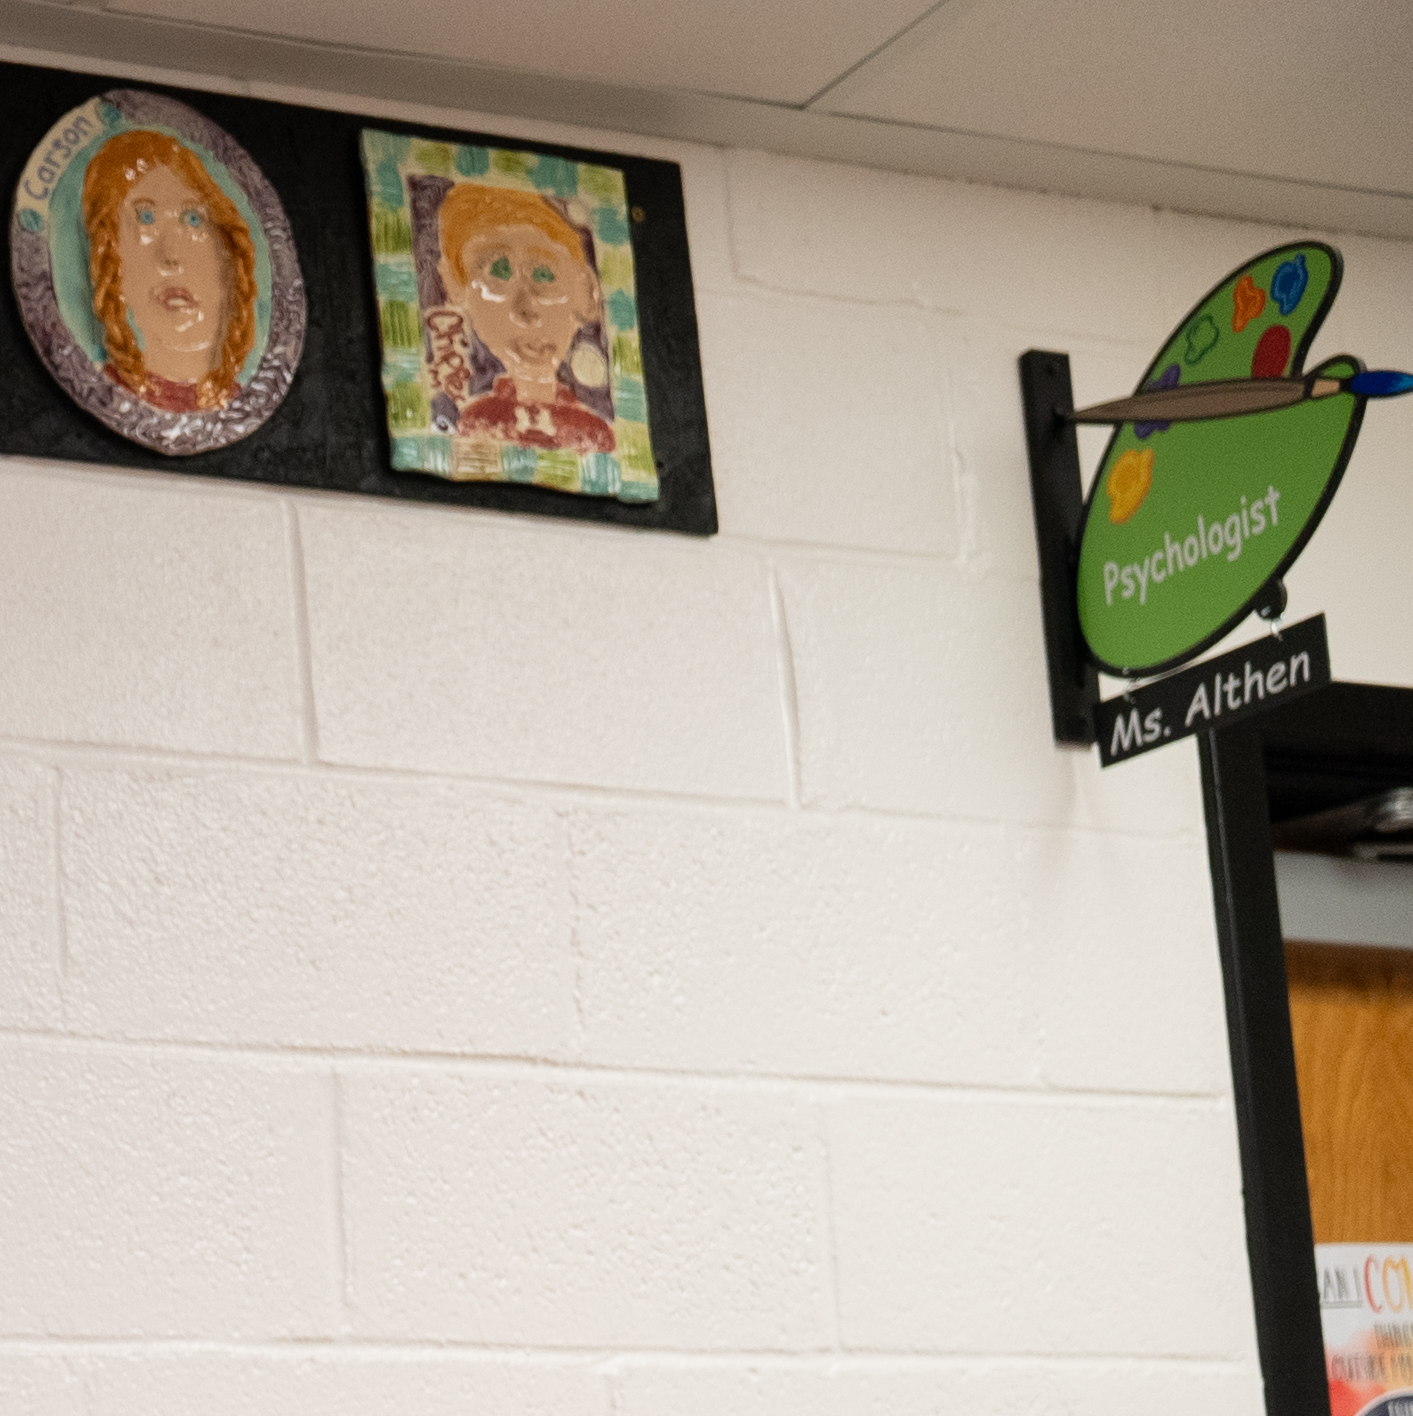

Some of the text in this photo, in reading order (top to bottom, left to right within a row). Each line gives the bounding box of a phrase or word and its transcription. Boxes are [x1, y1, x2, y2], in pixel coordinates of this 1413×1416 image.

[25, 115, 94, 200] Carson
[1104, 486, 1280, 605] Psychologist
[1111, 651, 1311, 757] Ms. Althen
